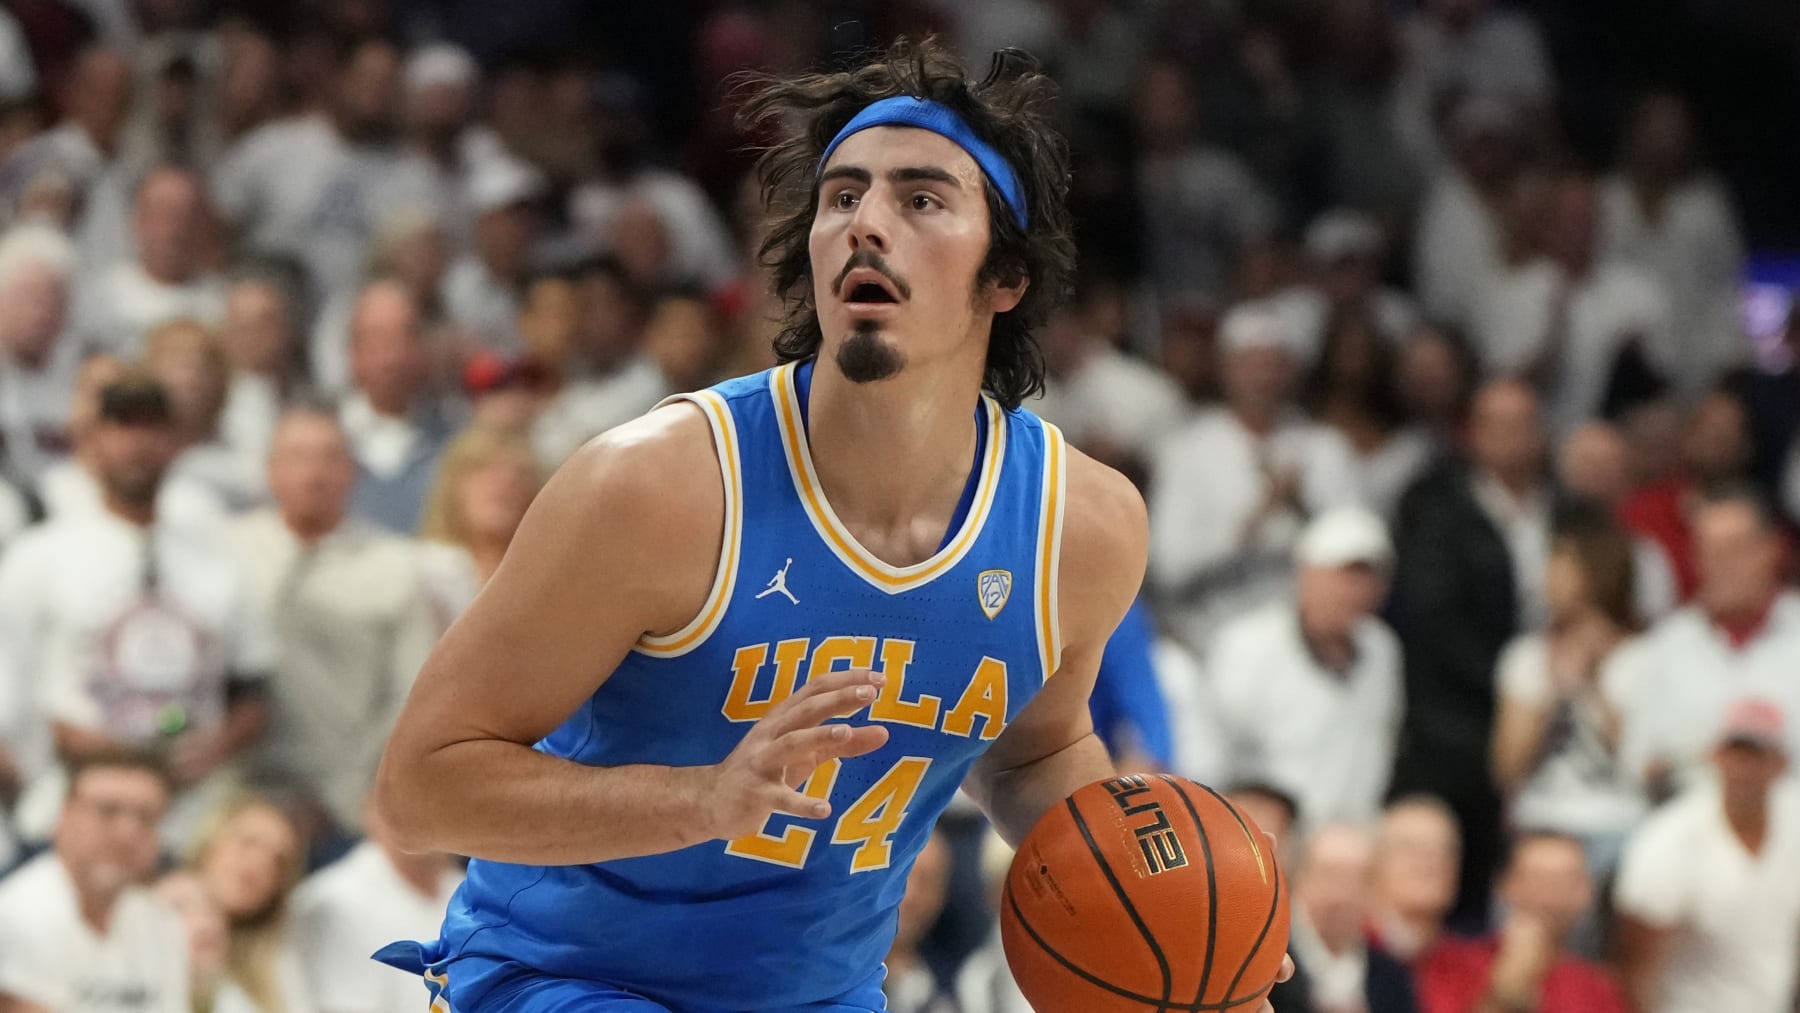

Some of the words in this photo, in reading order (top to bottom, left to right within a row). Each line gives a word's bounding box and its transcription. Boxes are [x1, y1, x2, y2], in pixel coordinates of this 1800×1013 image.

[981, 573, 1009, 599] PAC
[985, 591, 1001, 608] 12
[721, 635, 1008, 740] UCLA
[1101, 775, 1189, 876] ELITE
